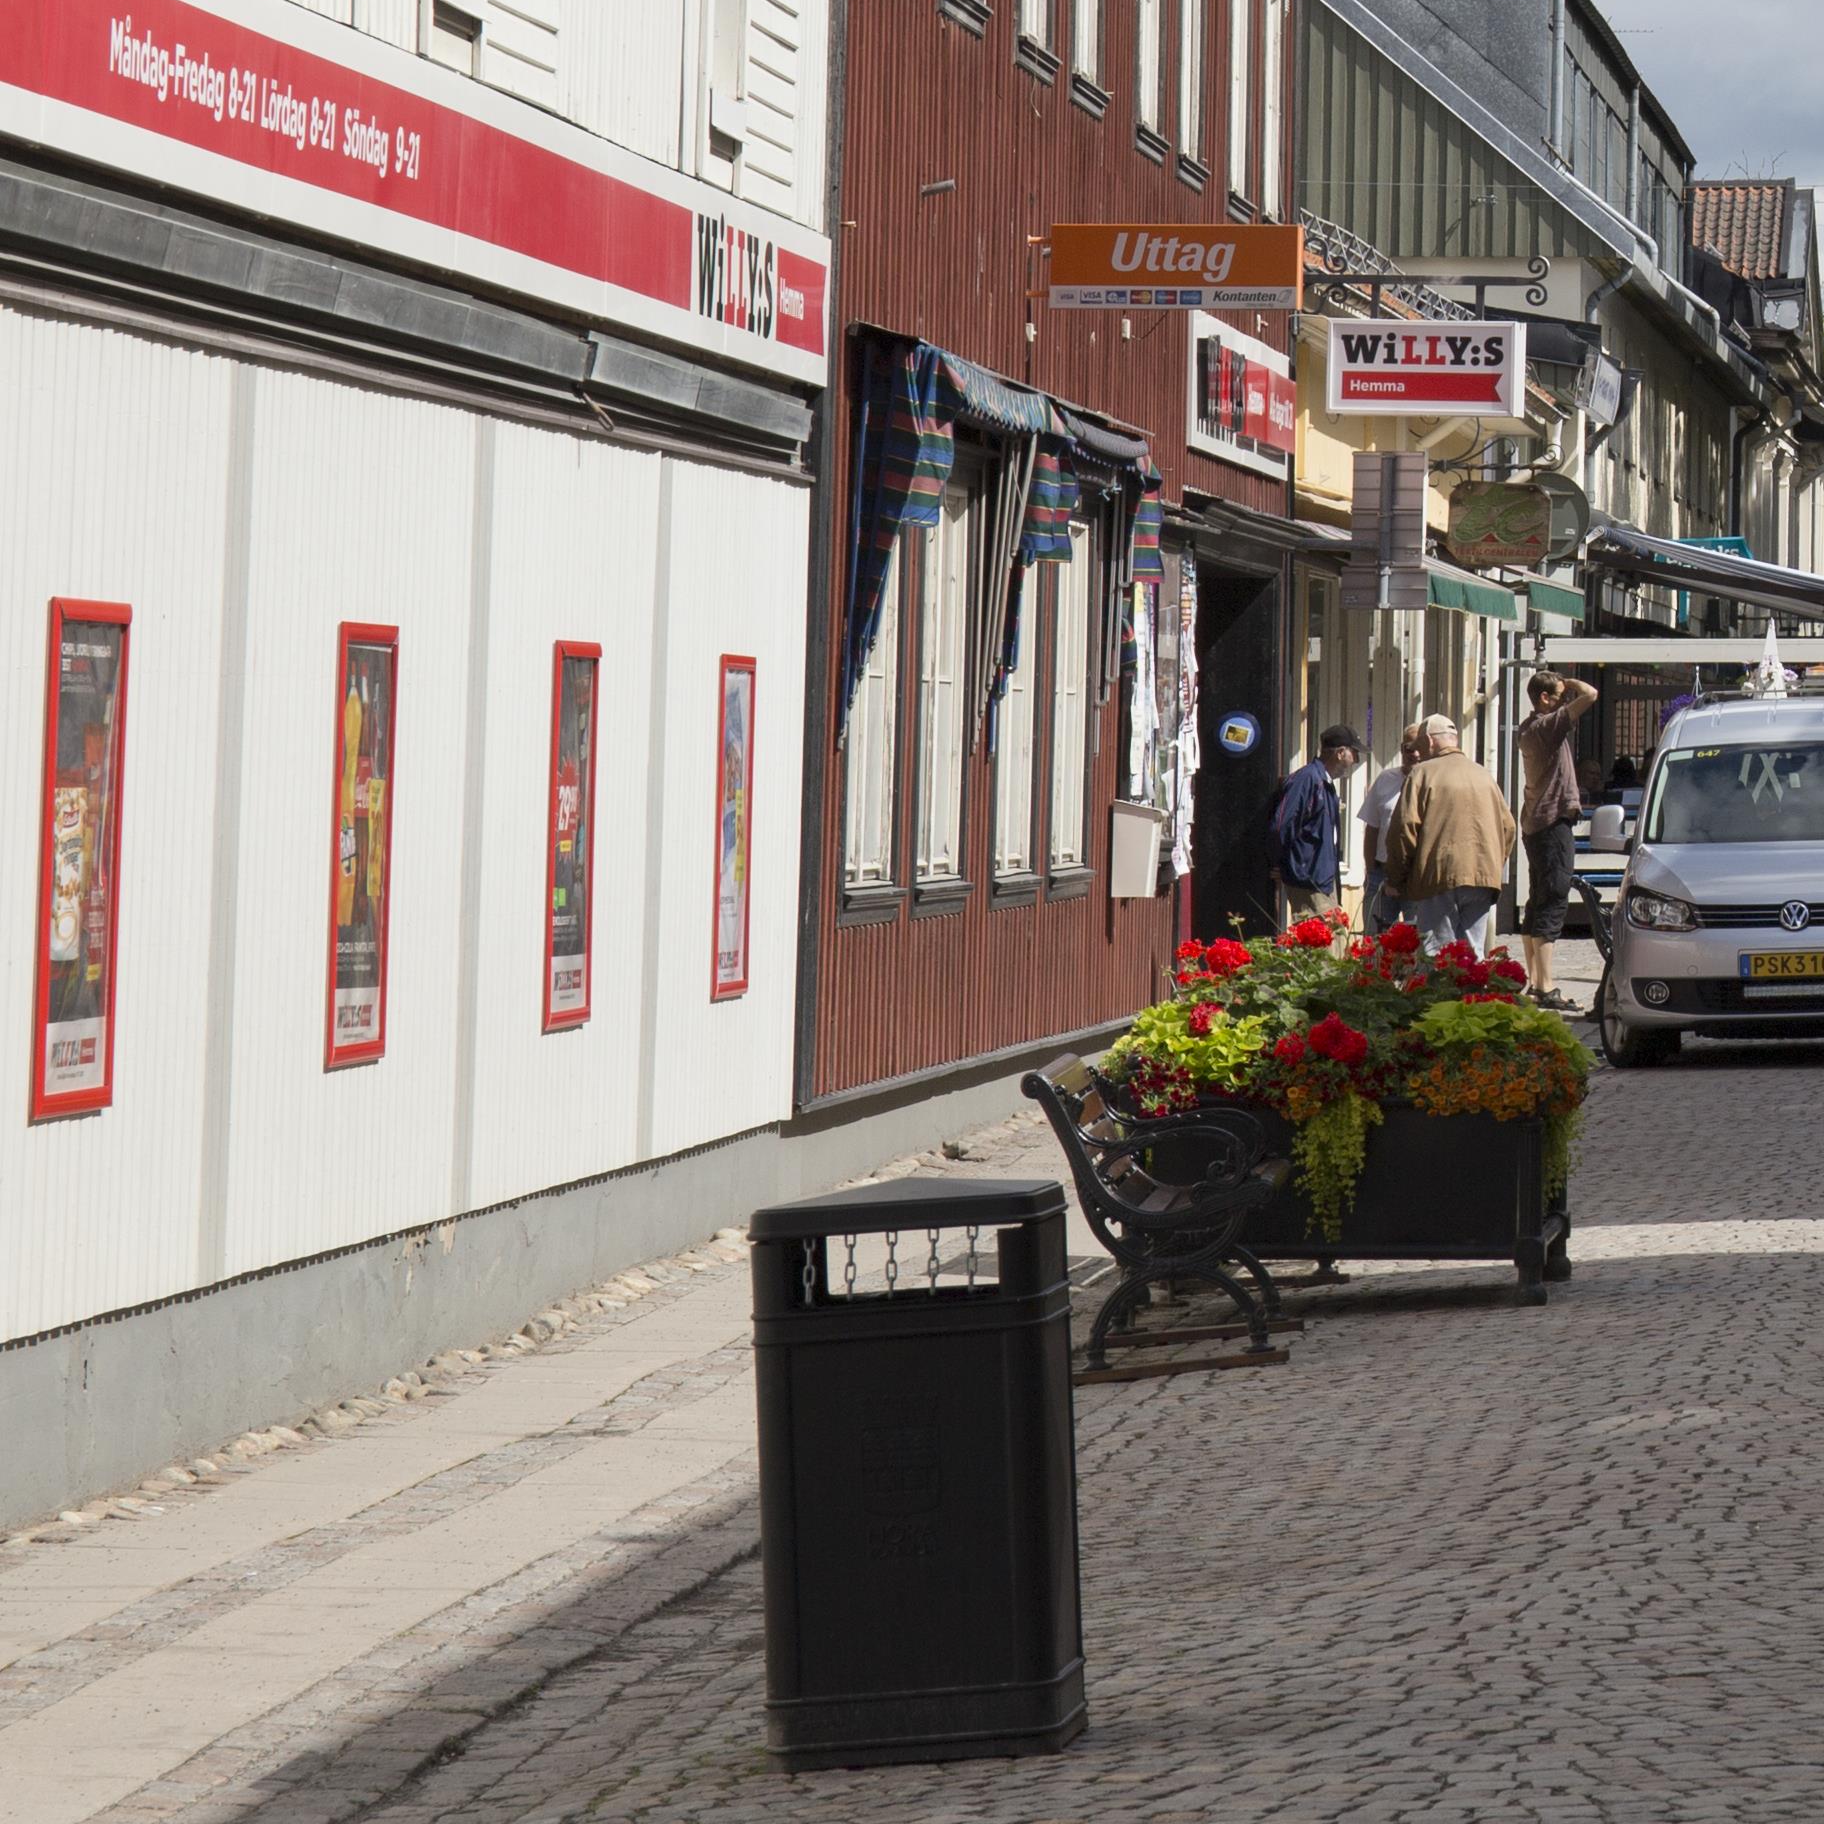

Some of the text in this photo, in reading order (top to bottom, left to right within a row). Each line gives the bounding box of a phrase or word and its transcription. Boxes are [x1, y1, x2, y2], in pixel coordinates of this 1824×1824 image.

[109, 14, 421, 181] Måndag-Fredag 8-21 Lördag 8-21 Söndag 9-21
[1111, 232, 1236, 283] Uttag
[779, 276, 805, 321] Hemma
[1212, 290, 1277, 303] Kontanten
[1350, 379, 1406, 393] Hemma
